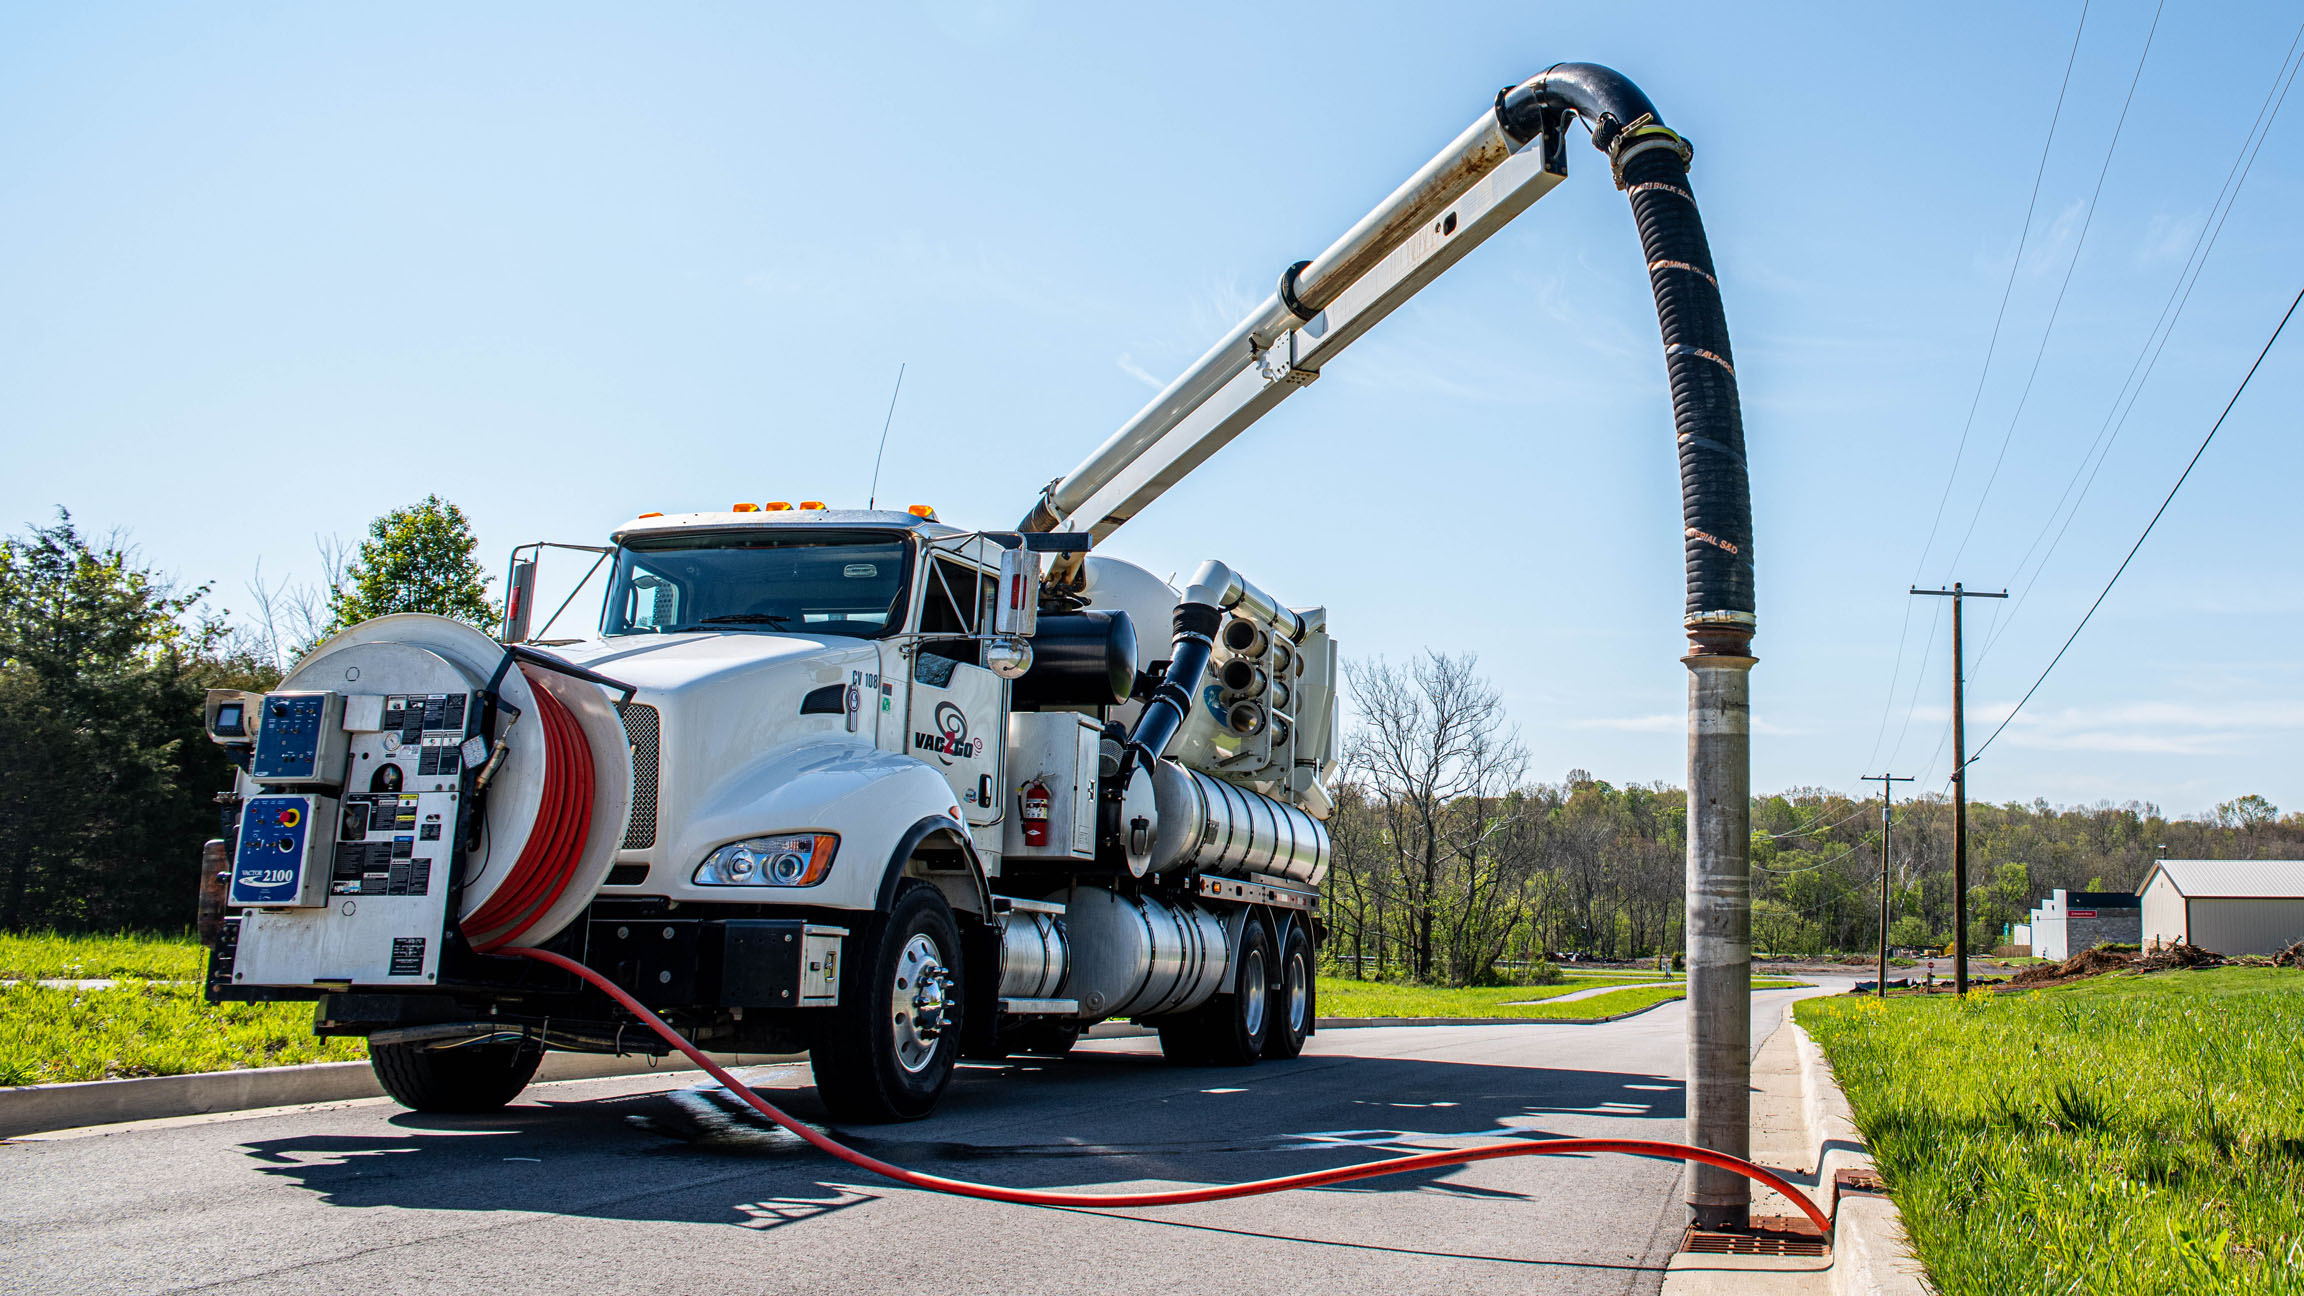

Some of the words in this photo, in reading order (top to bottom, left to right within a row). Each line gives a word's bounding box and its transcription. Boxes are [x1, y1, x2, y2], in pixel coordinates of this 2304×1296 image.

[1653, 182, 1677, 193] BULK
[1719, 539, 1738, 555] S&D
[852, 670, 862, 686] CV
[865, 672, 878, 689] 108
[915, 731, 974, 758] VAC2GO
[262, 869, 294, 882] 2100
